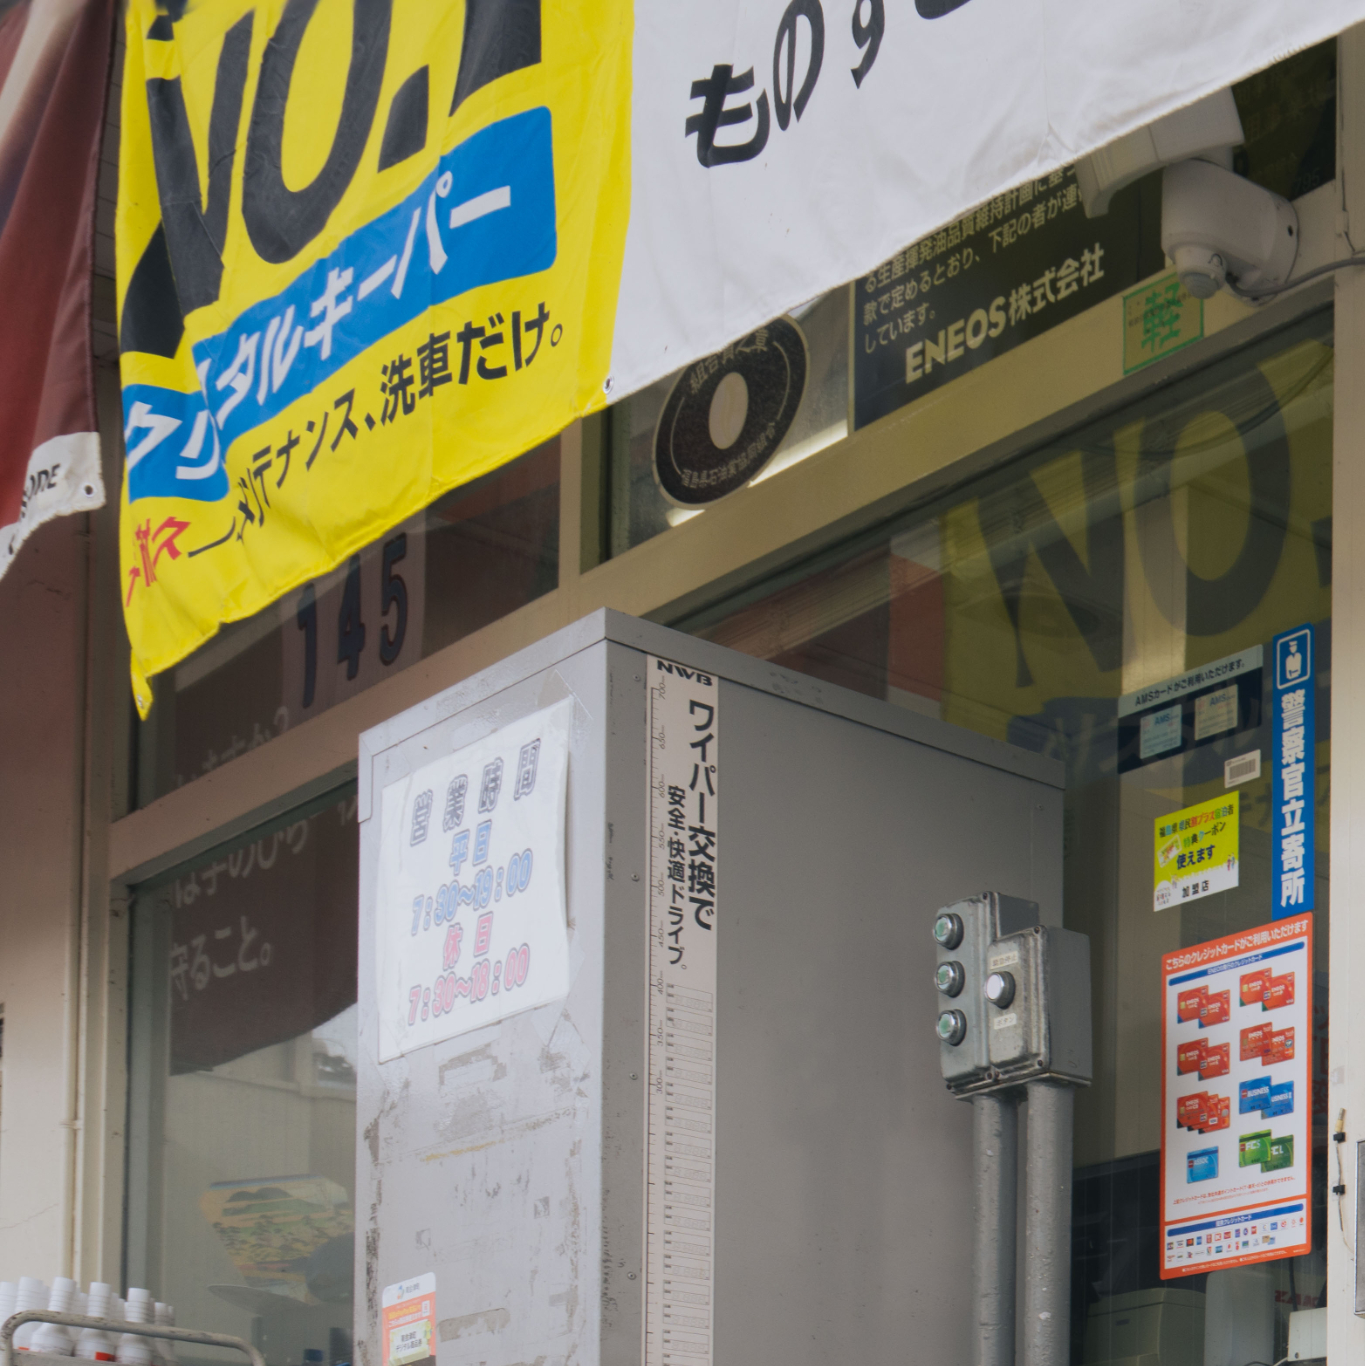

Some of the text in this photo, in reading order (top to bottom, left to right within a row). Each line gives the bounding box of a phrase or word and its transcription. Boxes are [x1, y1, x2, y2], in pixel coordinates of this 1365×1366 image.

[864, 302, 936, 354] しています。
[904, 242, 1106, 385] ENEOS株式会社
[656, 659, 714, 688] NWB
[1135, 658, 1246, 707] AMSカードがご利用いただけます。
[409, 737, 542, 847] 営業時間
[687, 698, 717, 932] ワイパー交換で
[1280, 688, 1306, 908] 警察官立寄所
[448, 818, 493, 877] 平日
[1177, 844, 1215, 871] 使えます
[666, 784, 688, 971] 安全・快適ドライブ。
[1182, 880, 1210, 899] 加盟店
[442, 910, 495, 973] 休日
[1165, 919, 1309, 971] こちらのクレジットカードがご利用いただけます
